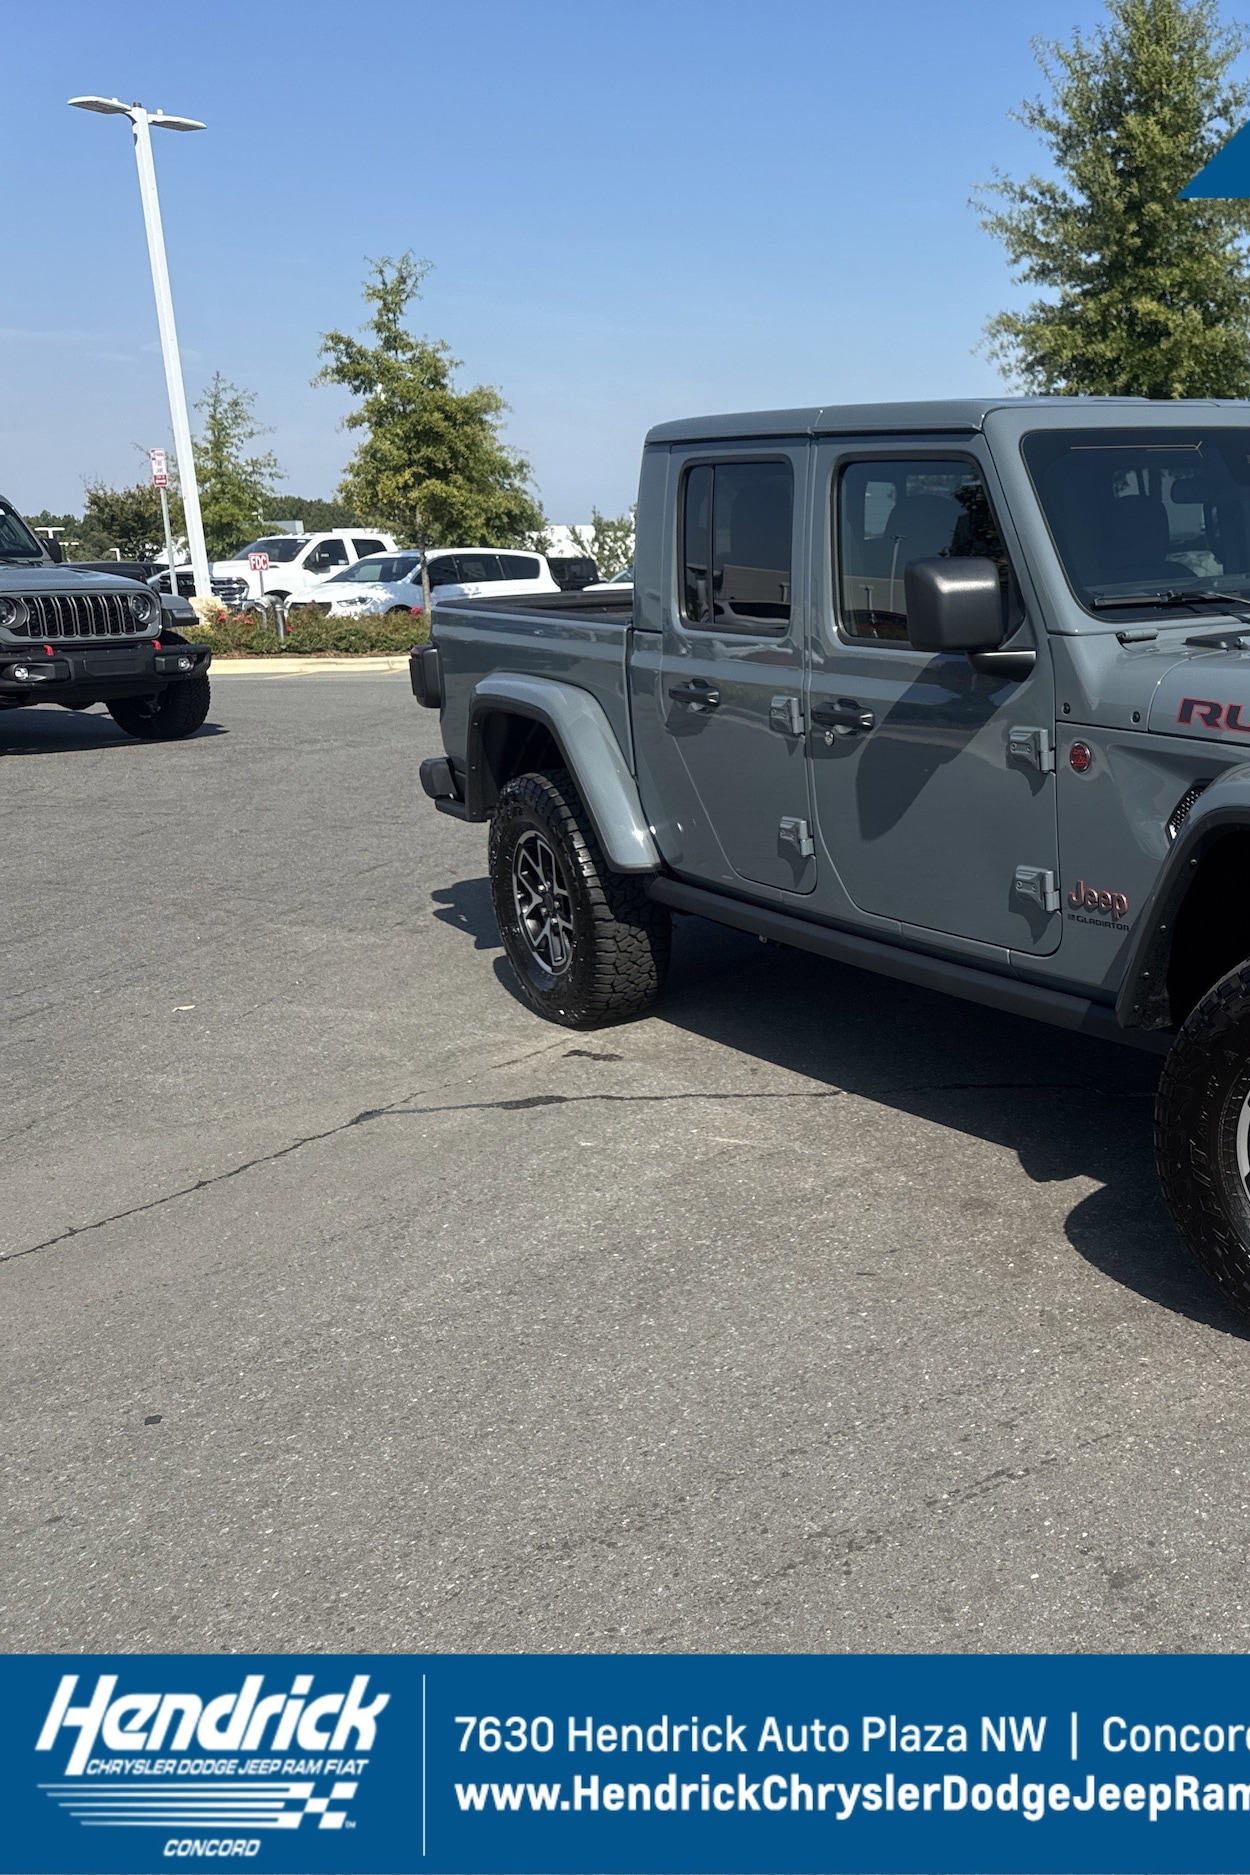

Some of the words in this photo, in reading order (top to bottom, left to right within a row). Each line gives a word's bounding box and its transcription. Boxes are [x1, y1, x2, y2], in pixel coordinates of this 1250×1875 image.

[250, 555, 268, 570] FDC
[1068, 880, 1129, 920] Jeep
[1076, 915, 1130, 932] GLADIATOR
